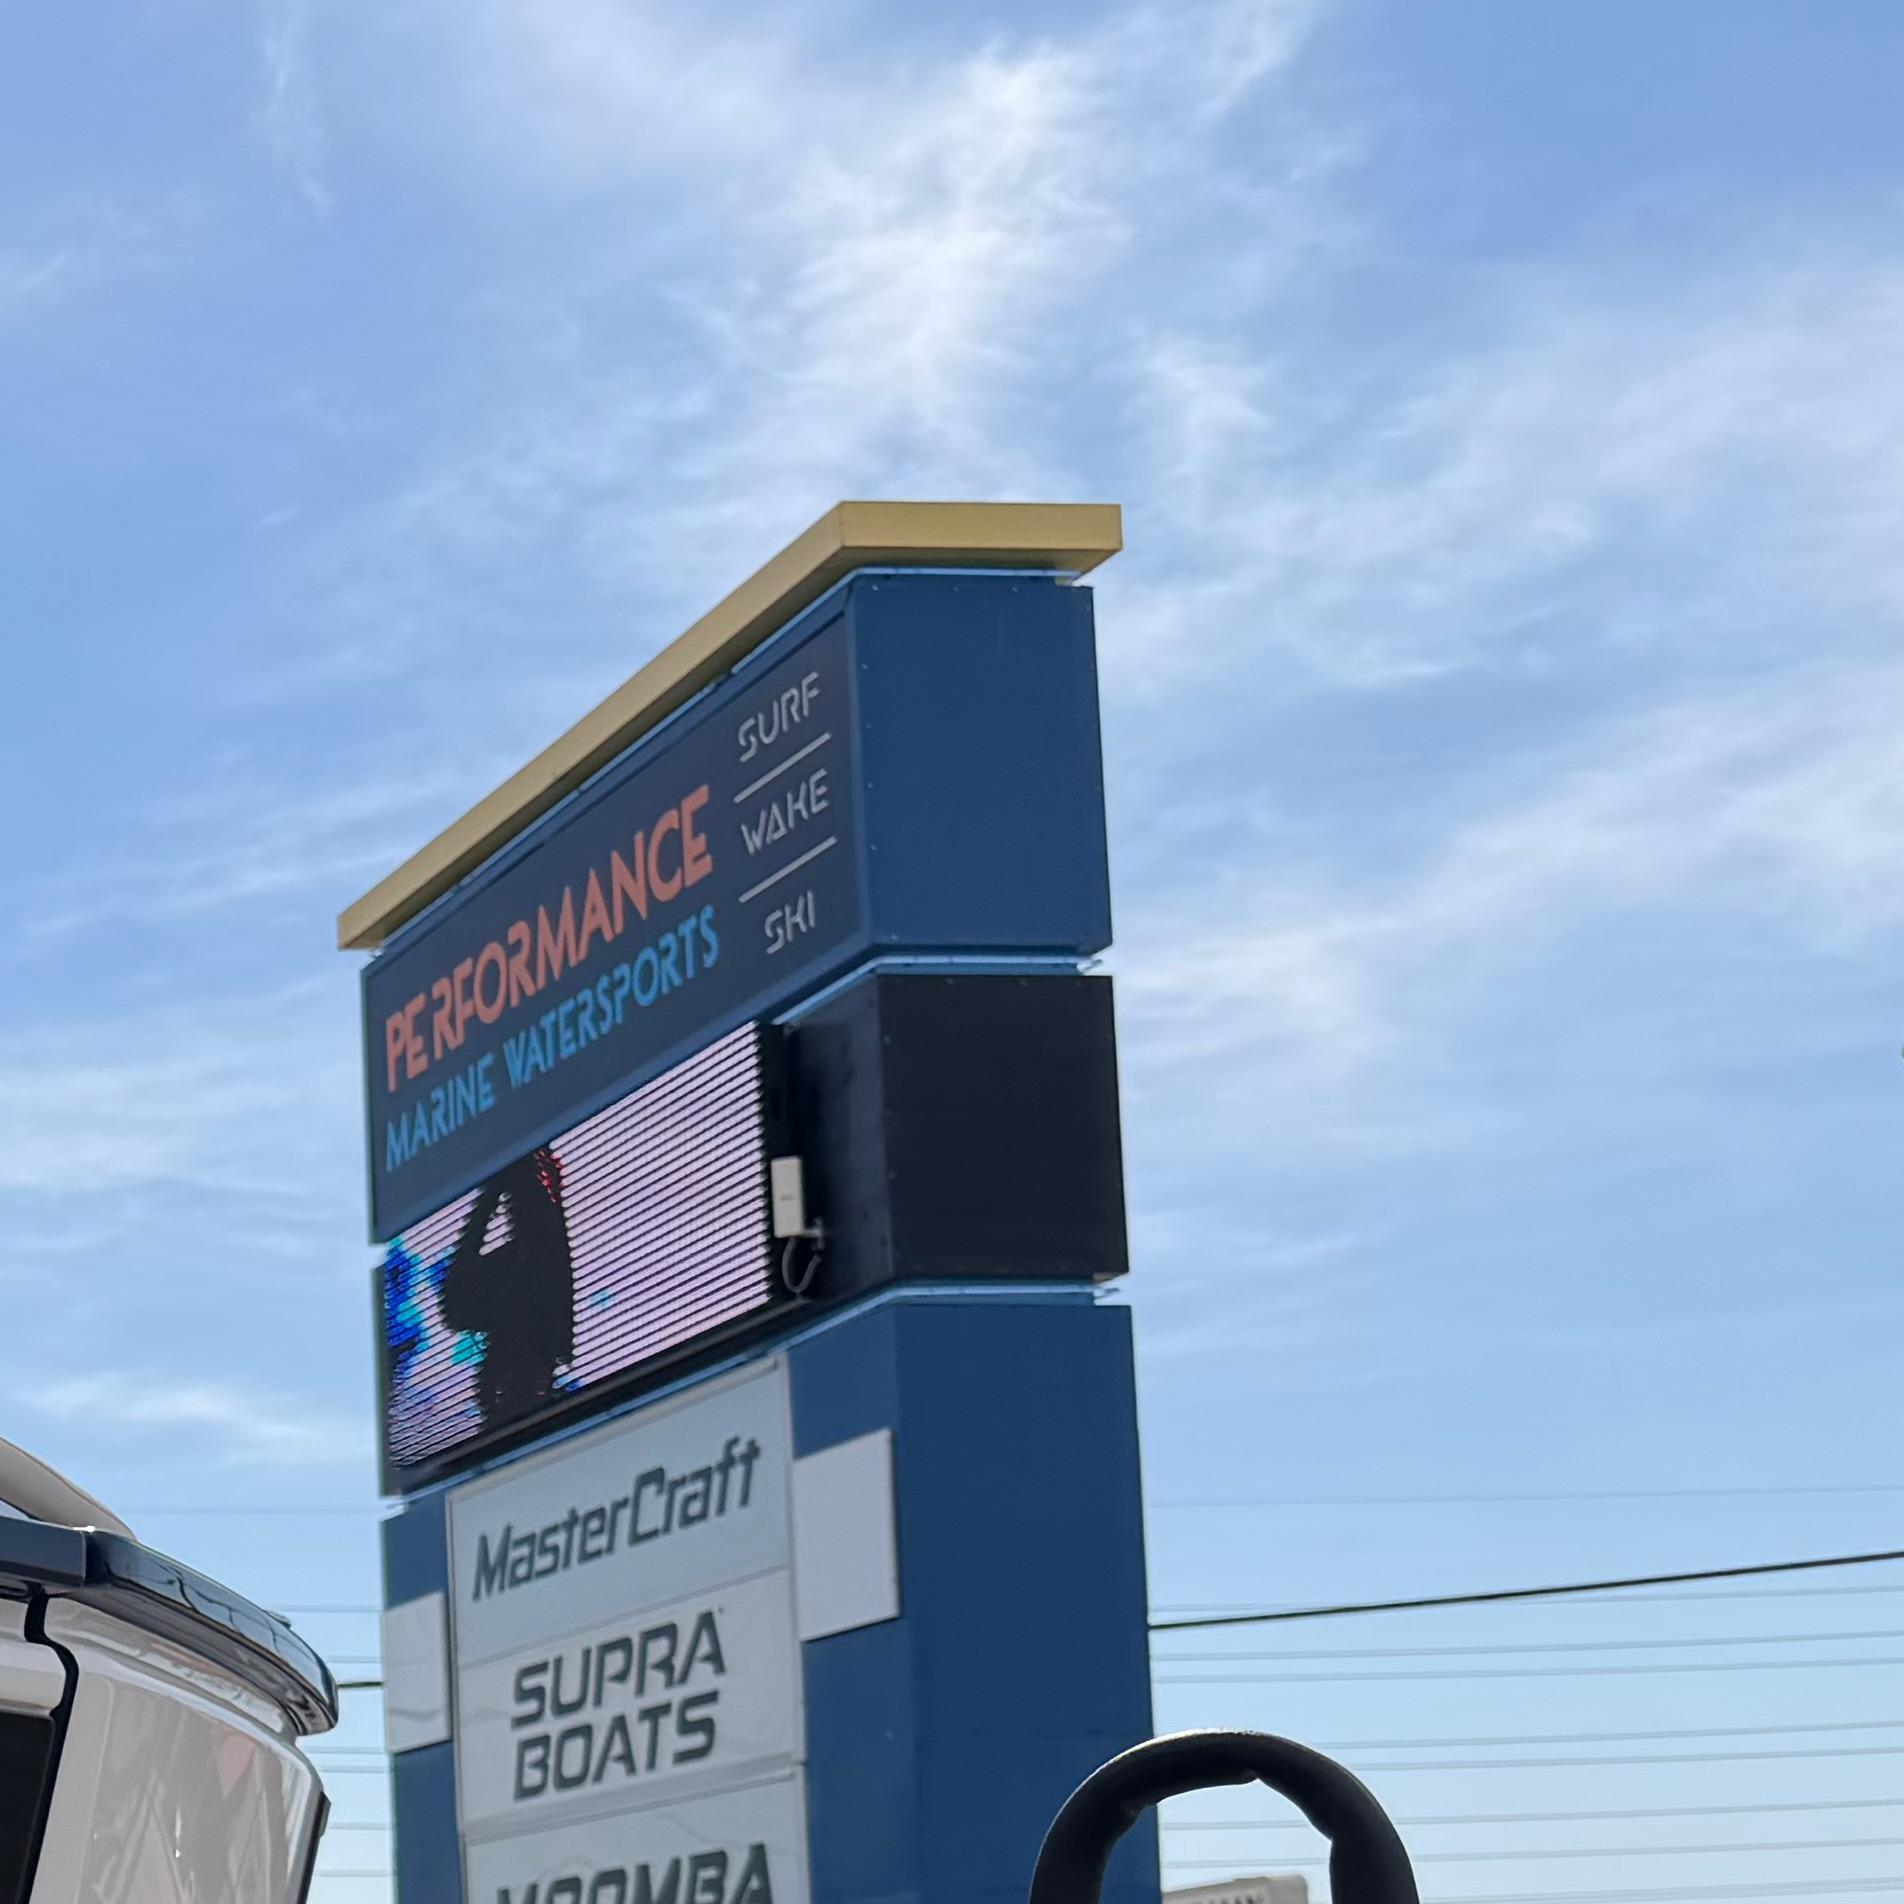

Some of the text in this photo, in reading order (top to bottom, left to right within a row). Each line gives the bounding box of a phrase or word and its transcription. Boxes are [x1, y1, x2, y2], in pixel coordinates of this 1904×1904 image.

[737, 671, 822, 763] SURF
[740, 769, 831, 856] WAKE
[384, 783, 715, 1093] PERFORMANCE
[762, 889, 818, 955] SKI
[384, 904, 721, 1173] MARINE WATERSPORTS
[472, 1435, 762, 1602] MasterCraft
[510, 1610, 726, 1729] SUPRA
[513, 1690, 720, 1800] BOATS
